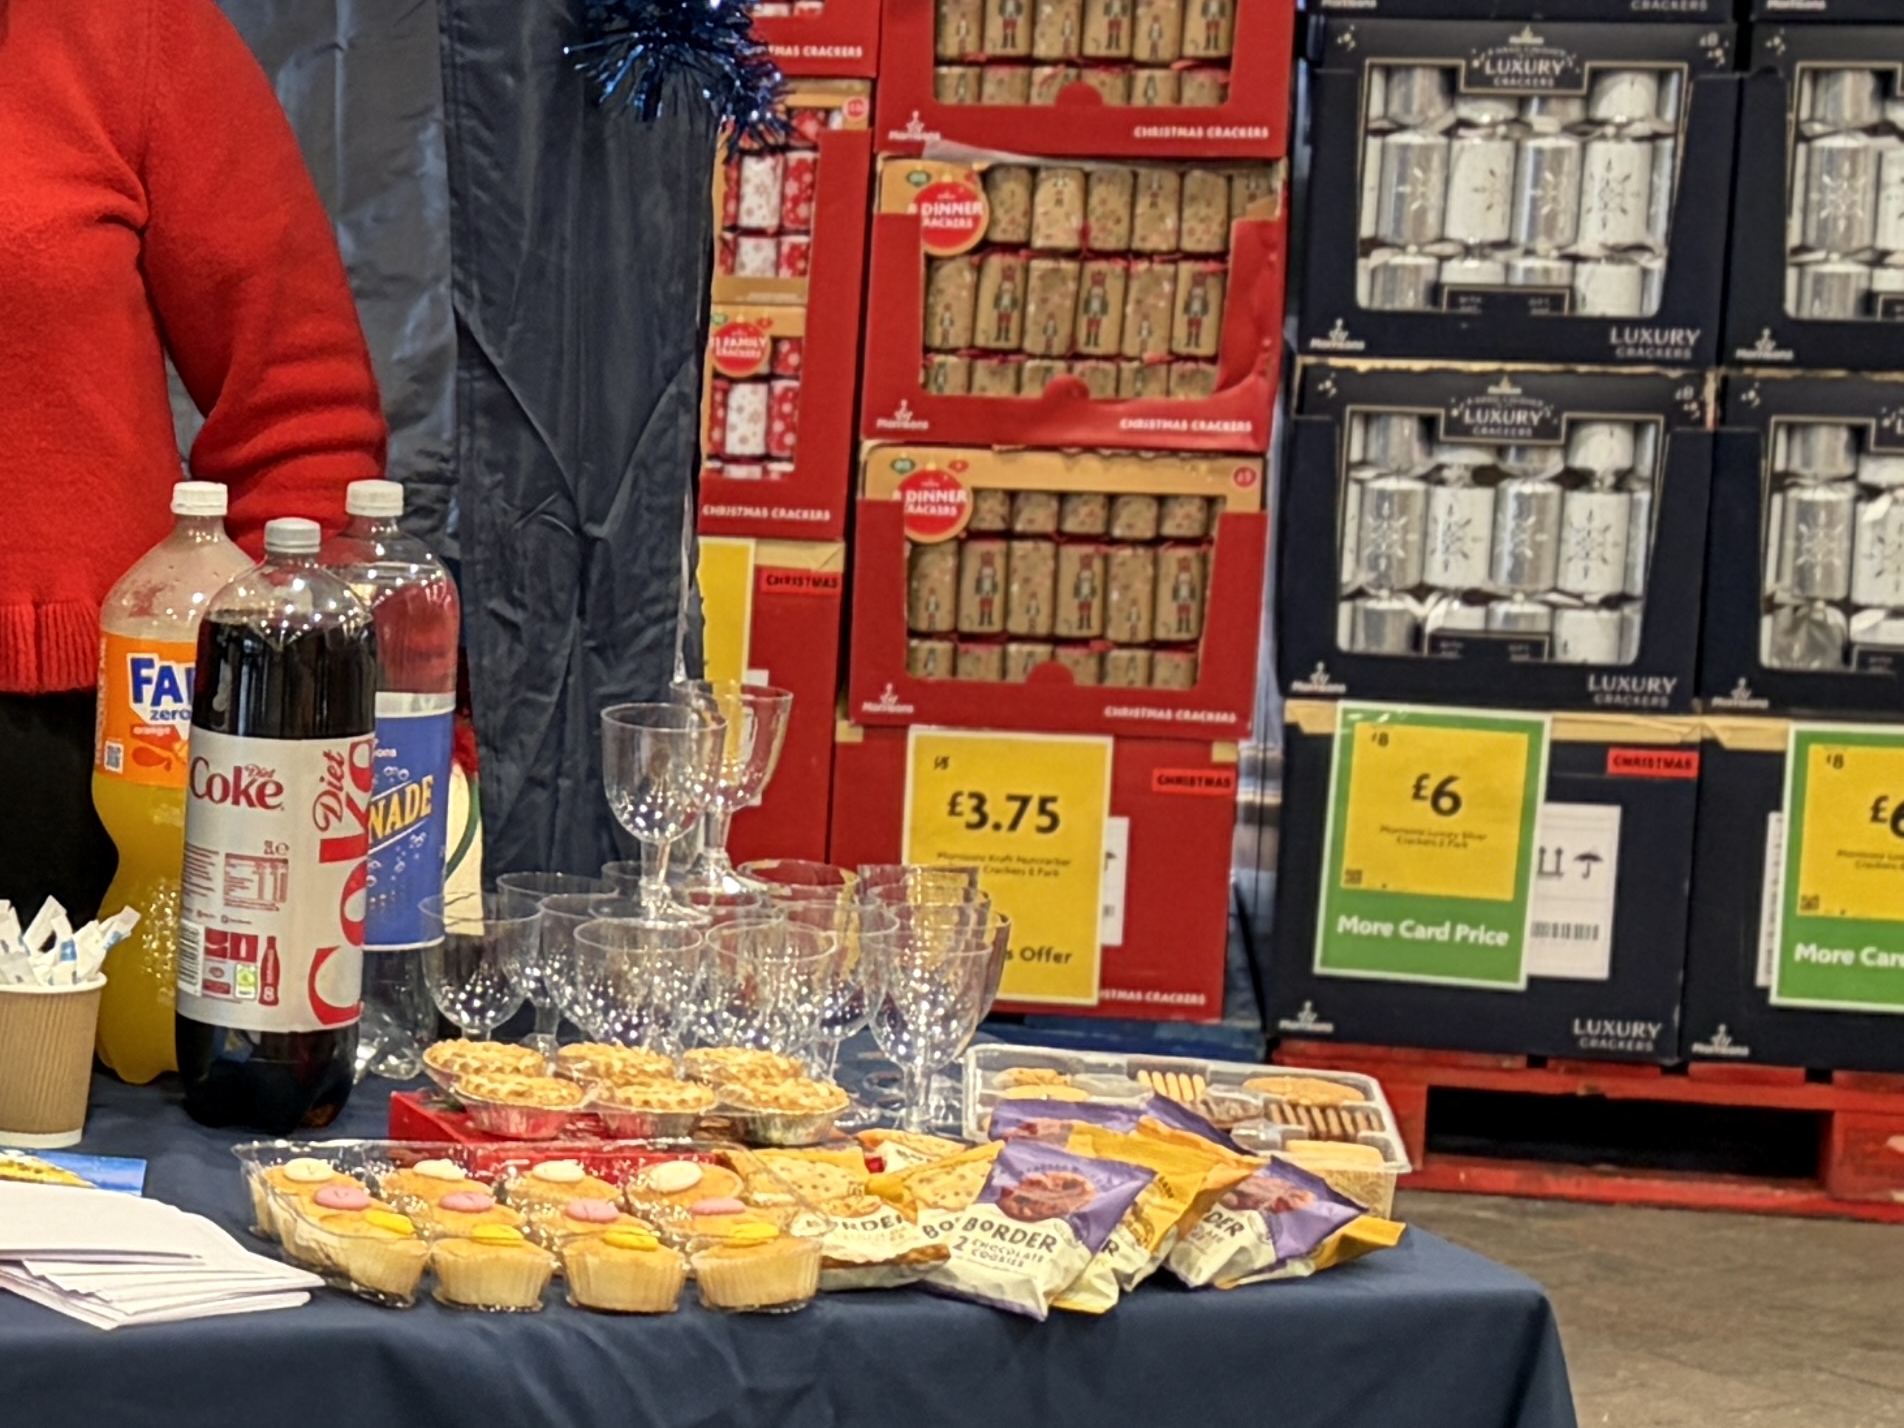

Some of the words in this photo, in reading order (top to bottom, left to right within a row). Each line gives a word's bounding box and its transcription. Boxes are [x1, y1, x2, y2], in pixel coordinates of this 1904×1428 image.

[1631, 0, 1707, 12] CRACKERS
[802, 45, 863, 58] CRACKERS
[1484, 57, 1565, 75] LUXURY
[1133, 126, 1204, 139] CHRISTMAS
[1206, 127, 1269, 139] CRACKERS
[1610, 326, 1700, 346] LUXURY
[1616, 346, 1692, 360] CRACKERS
[1120, 419, 1189, 431] CHRISTMAS
[1191, 420, 1253, 432] CRACKERS
[1464, 408, 1544, 427] LUXURY
[702, 505, 769, 520] CHRISTMAS
[771, 508, 831, 521] CRACKERS
[766, 575, 838, 590] CHRISTMAS
[1588, 674, 1678, 694] LUXURY
[1594, 693, 1669, 707] CRACKERS
[1104, 706, 1172, 721] CHRISTMAS
[1176, 708, 1237, 723] CRACKERS
[1613, 755, 1692, 770] CHRISTMAS
[189, 756, 284, 811] Coke
[312, 748, 345, 833] Diet
[1156, 774, 1231, 790] CHRISTMAS
[1411, 772, 1462, 817] £6
[368, 774, 434, 845] NADE
[947, 790, 1060, 834] £3.75
[1337, 913, 1394, 937] More
[1398, 918, 1452, 943] Card
[1455, 922, 1509, 948] Price
[1020, 947, 1073, 965] Offer
[1794, 942, 1855, 967] More
[1145, 992, 1205, 1006] CRACKERS
[1573, 1018, 1662, 1039] LUXURY
[1580, 1038, 1653, 1053] CRACKERS
[962, 1217, 1058, 1254] BORDER
[952, 1235, 969, 1252] 2
[971, 1238, 1045, 1264] CHOCOLATE
[971, 1248, 1025, 1268] COOKIES
